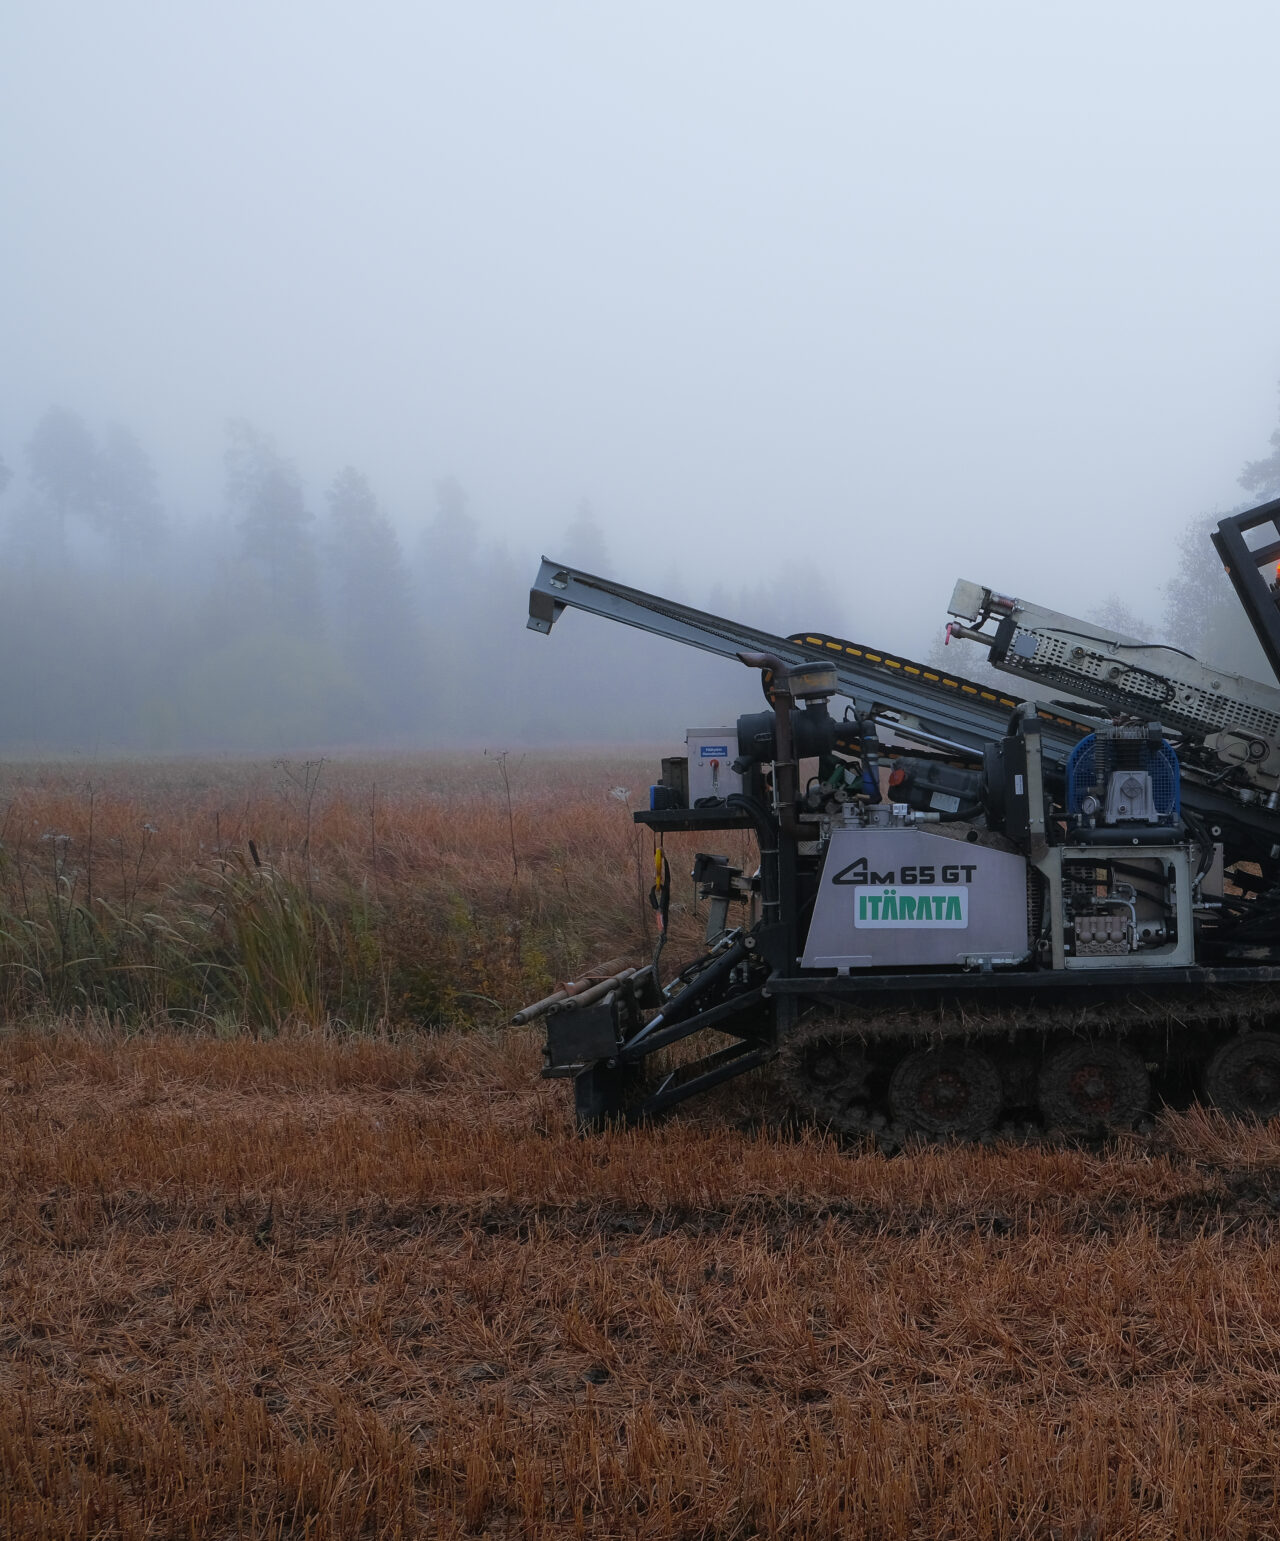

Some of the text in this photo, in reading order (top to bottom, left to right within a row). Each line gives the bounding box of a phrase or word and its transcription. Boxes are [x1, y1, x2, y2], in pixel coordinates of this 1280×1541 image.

[900, 866, 936, 885] 65
[942, 865, 977, 884] GT
[859, 889, 962, 921] ITÄRATA
